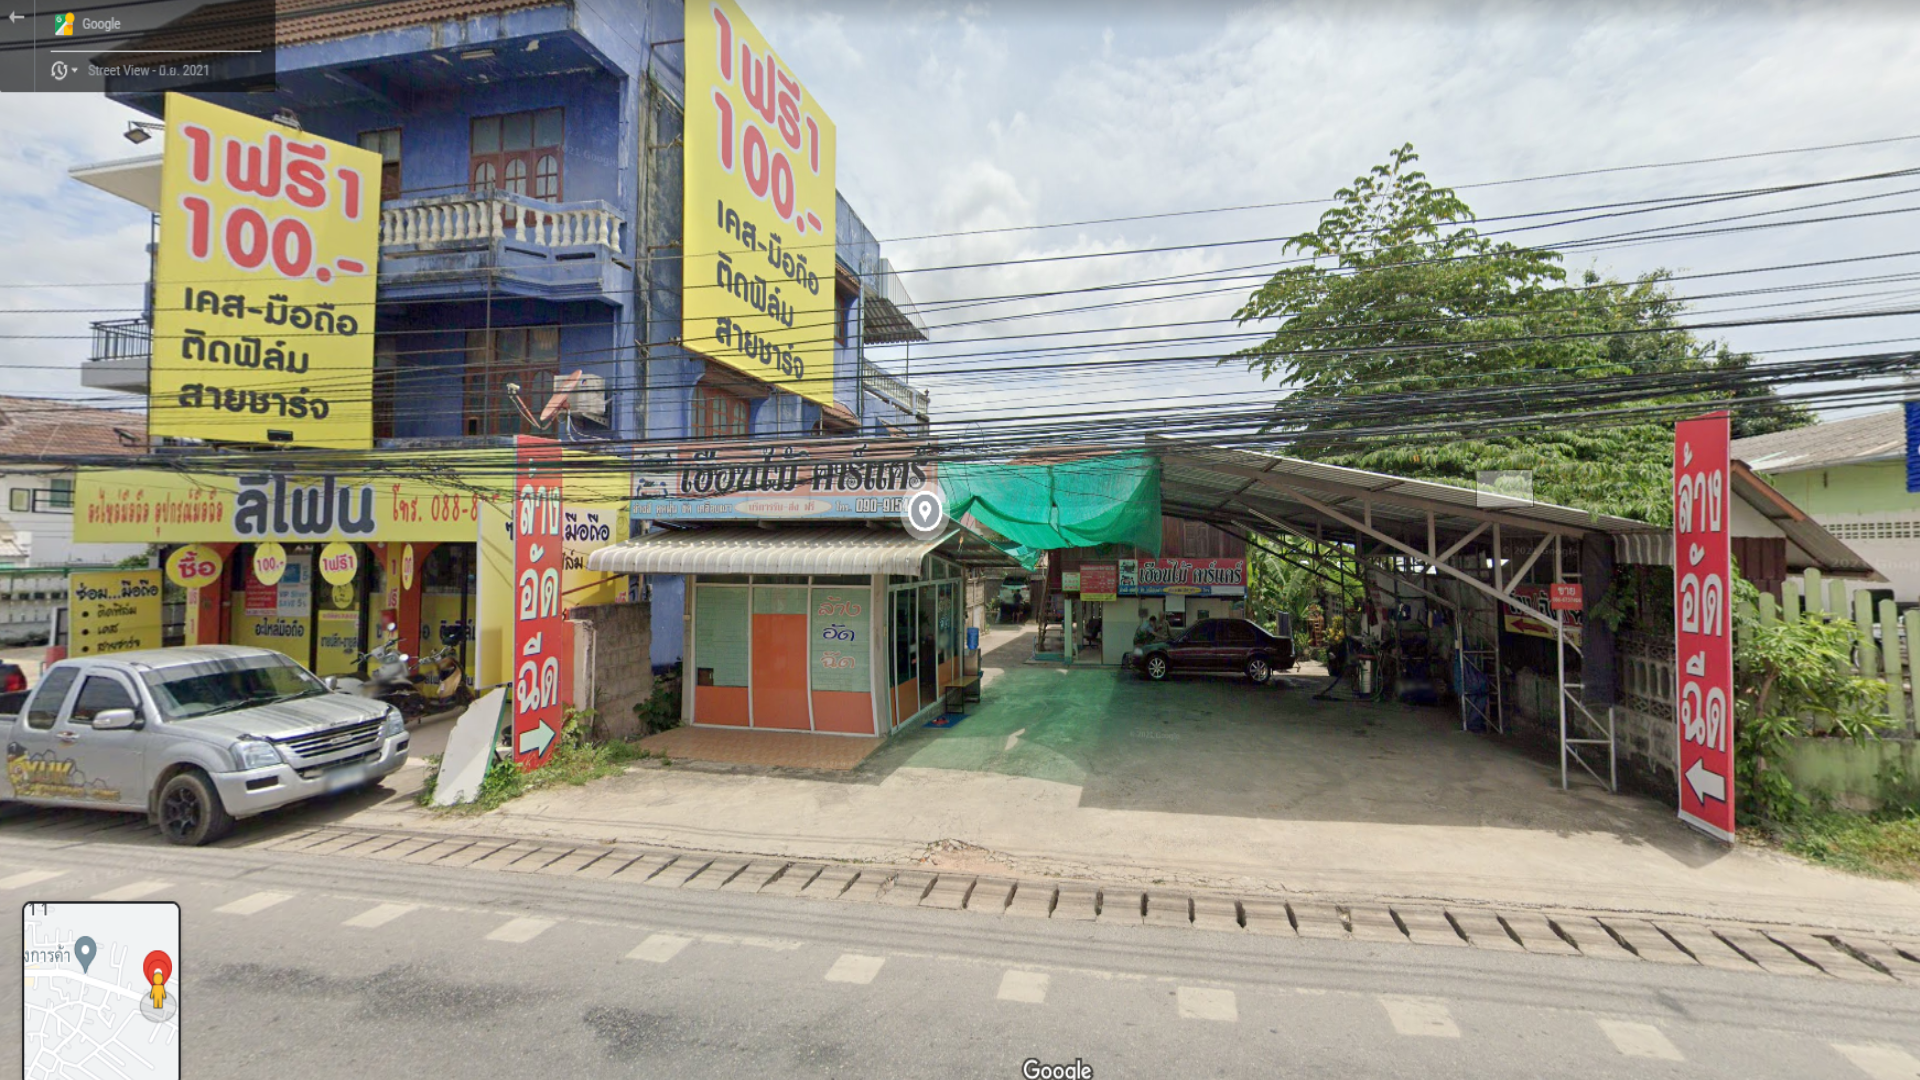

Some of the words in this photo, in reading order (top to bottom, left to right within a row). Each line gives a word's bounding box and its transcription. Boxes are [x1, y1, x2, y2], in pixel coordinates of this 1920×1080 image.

[715, 92, 822, 232] 100.-
[183, 197, 364, 283] 100.-
[717, 200, 819, 295] เคส-มือถือ
[185, 287, 358, 336] เคส-มือถือ
[717, 251, 793, 328] ติดฟิล์ม
[182, 330, 309, 374] ติดฟิล์ม
[716, 317, 804, 379] สายชาร์จ
[179, 383, 329, 420] สายชาร์จ
[392, 483, 422, 522] โทร.
[431, 492, 499, 522] 088-8
[1678, 442, 1722, 534] ล้าง
[178, 551, 216, 579] ซื้อ
[520, 543, 559, 620] อัด
[1681, 543, 1722, 637] อัด
[818, 597, 861, 617] ล้าง
[822, 624, 855, 641] อัด
[516, 632, 559, 714] ฉีด
[820, 652, 855, 669] ฉีด
[1681, 651, 1726, 753] ฉีด
